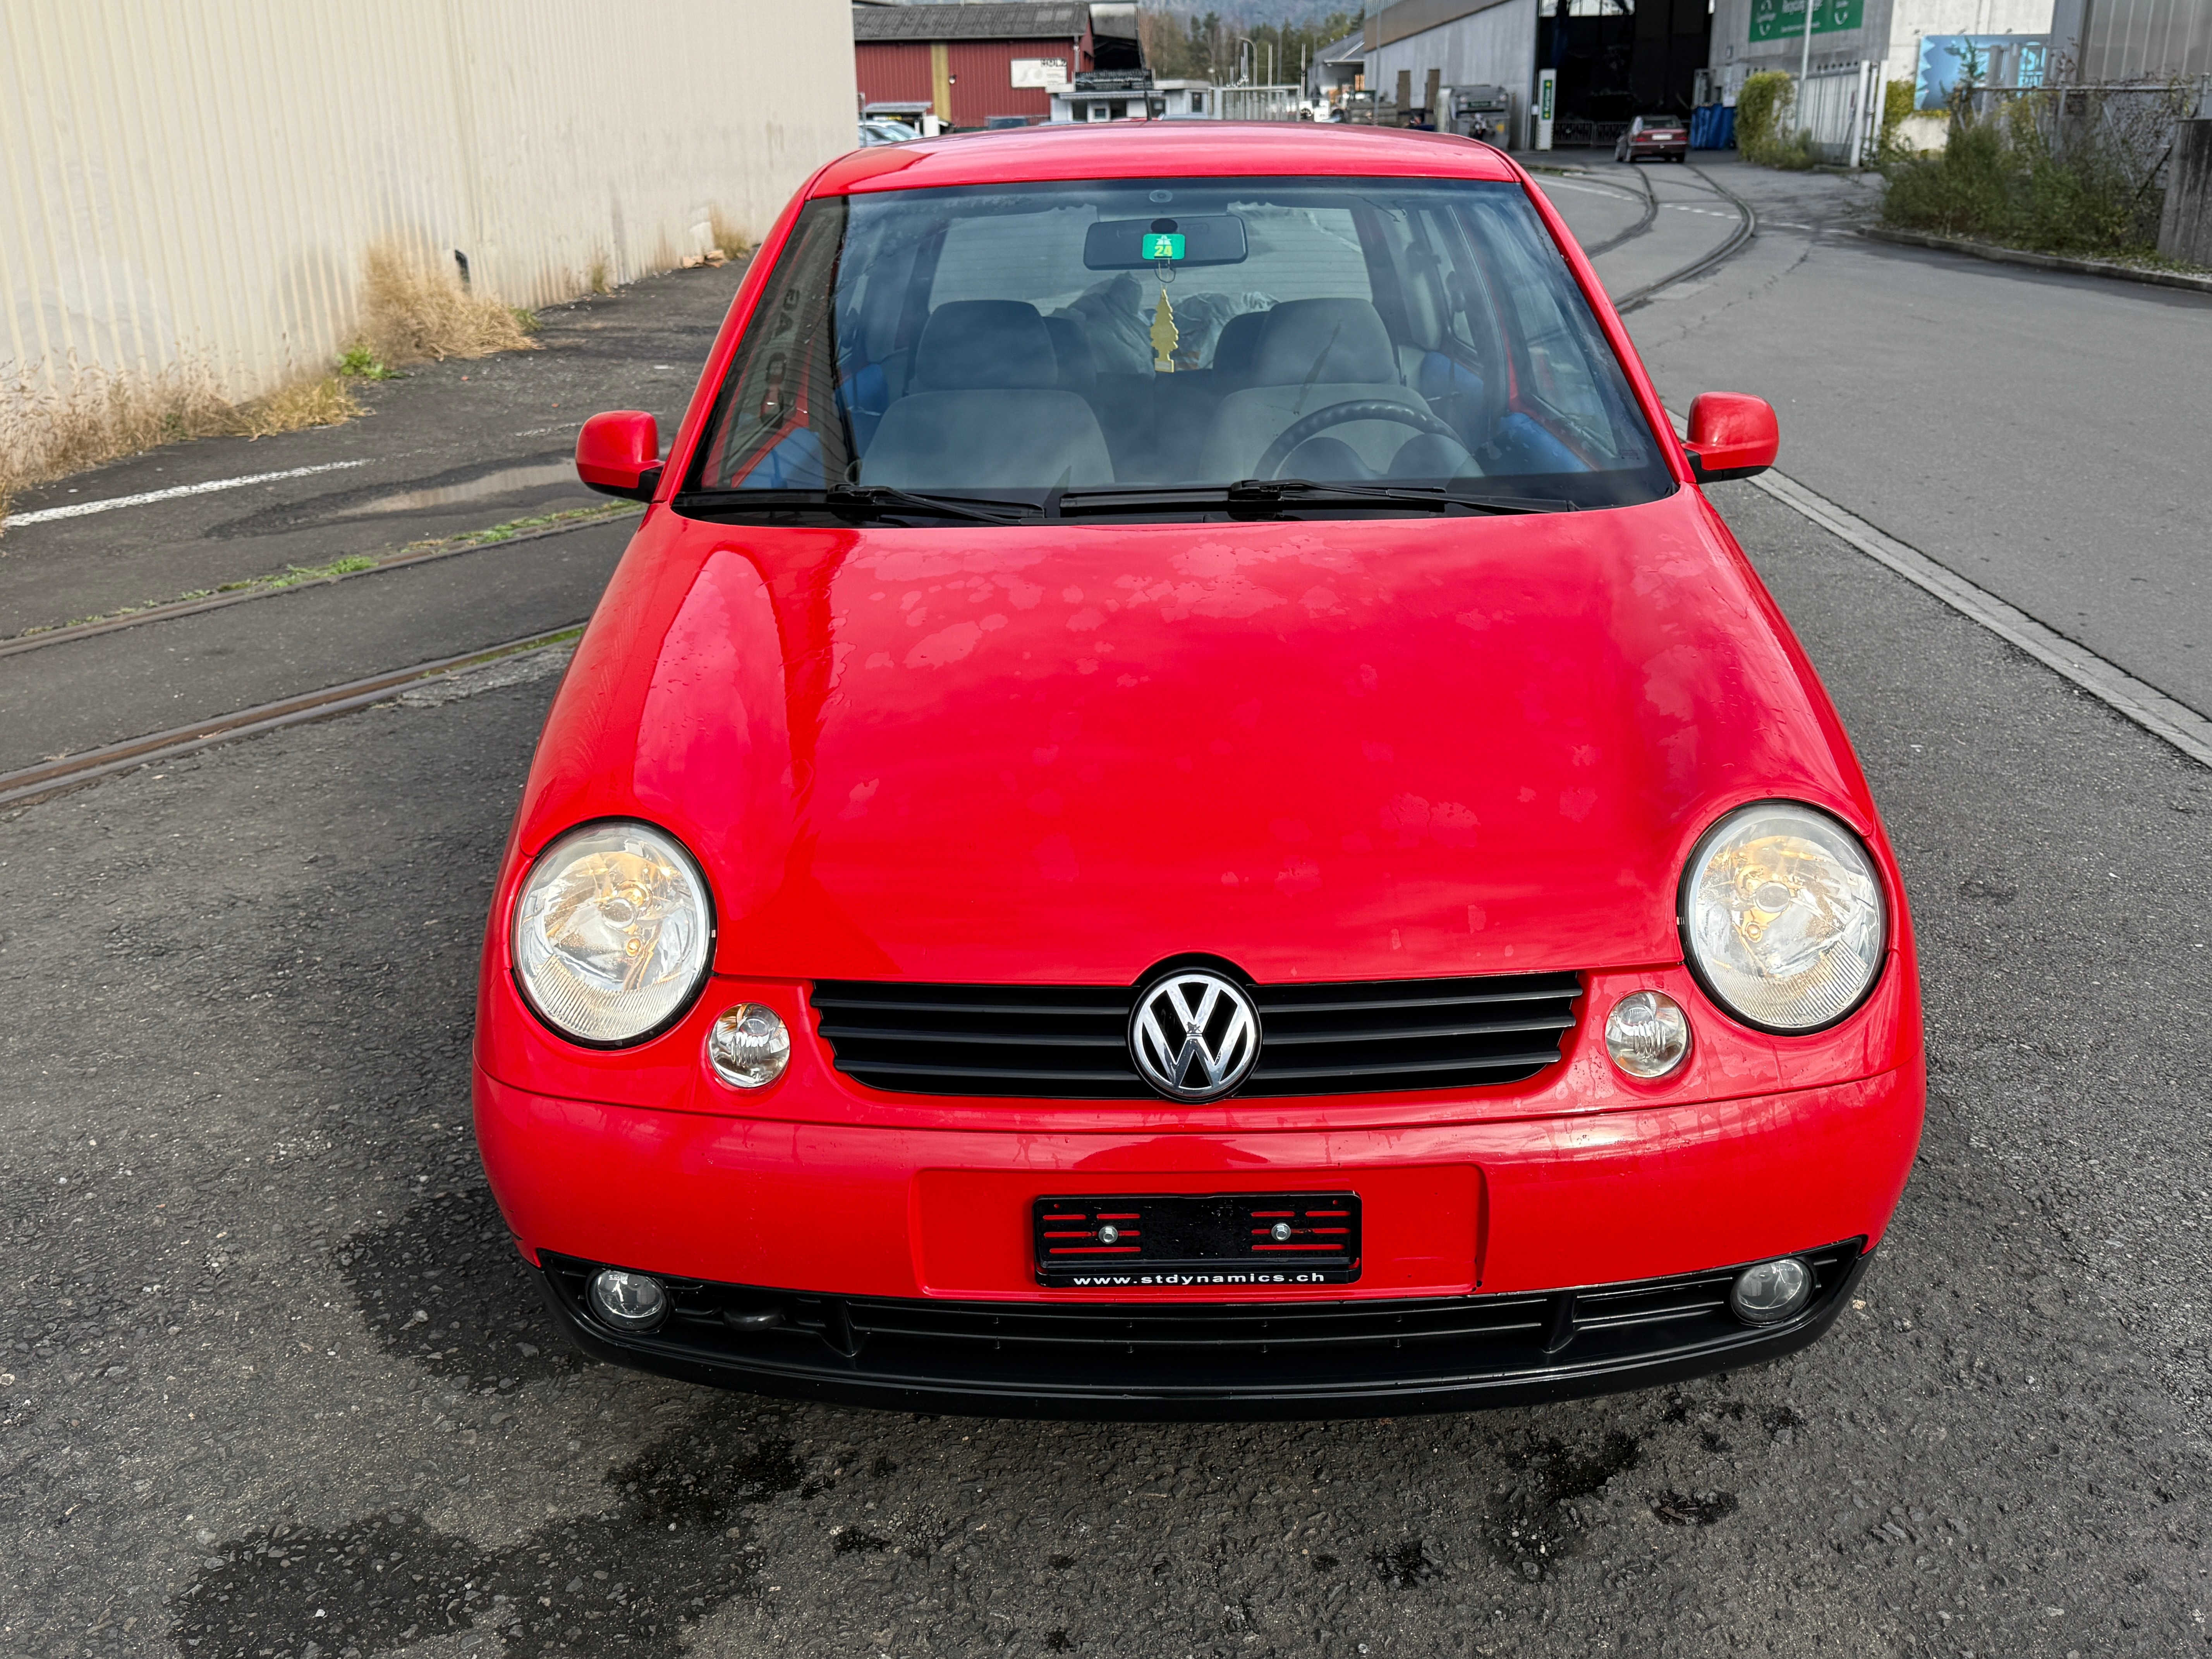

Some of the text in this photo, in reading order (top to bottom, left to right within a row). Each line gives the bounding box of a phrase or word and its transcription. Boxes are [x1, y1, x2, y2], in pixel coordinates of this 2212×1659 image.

[1154, 245, 1173, 256] 24
[1133, 974, 1255, 1096] VW
[1073, 1273, 1324, 1286] www.stdynamics.ch
